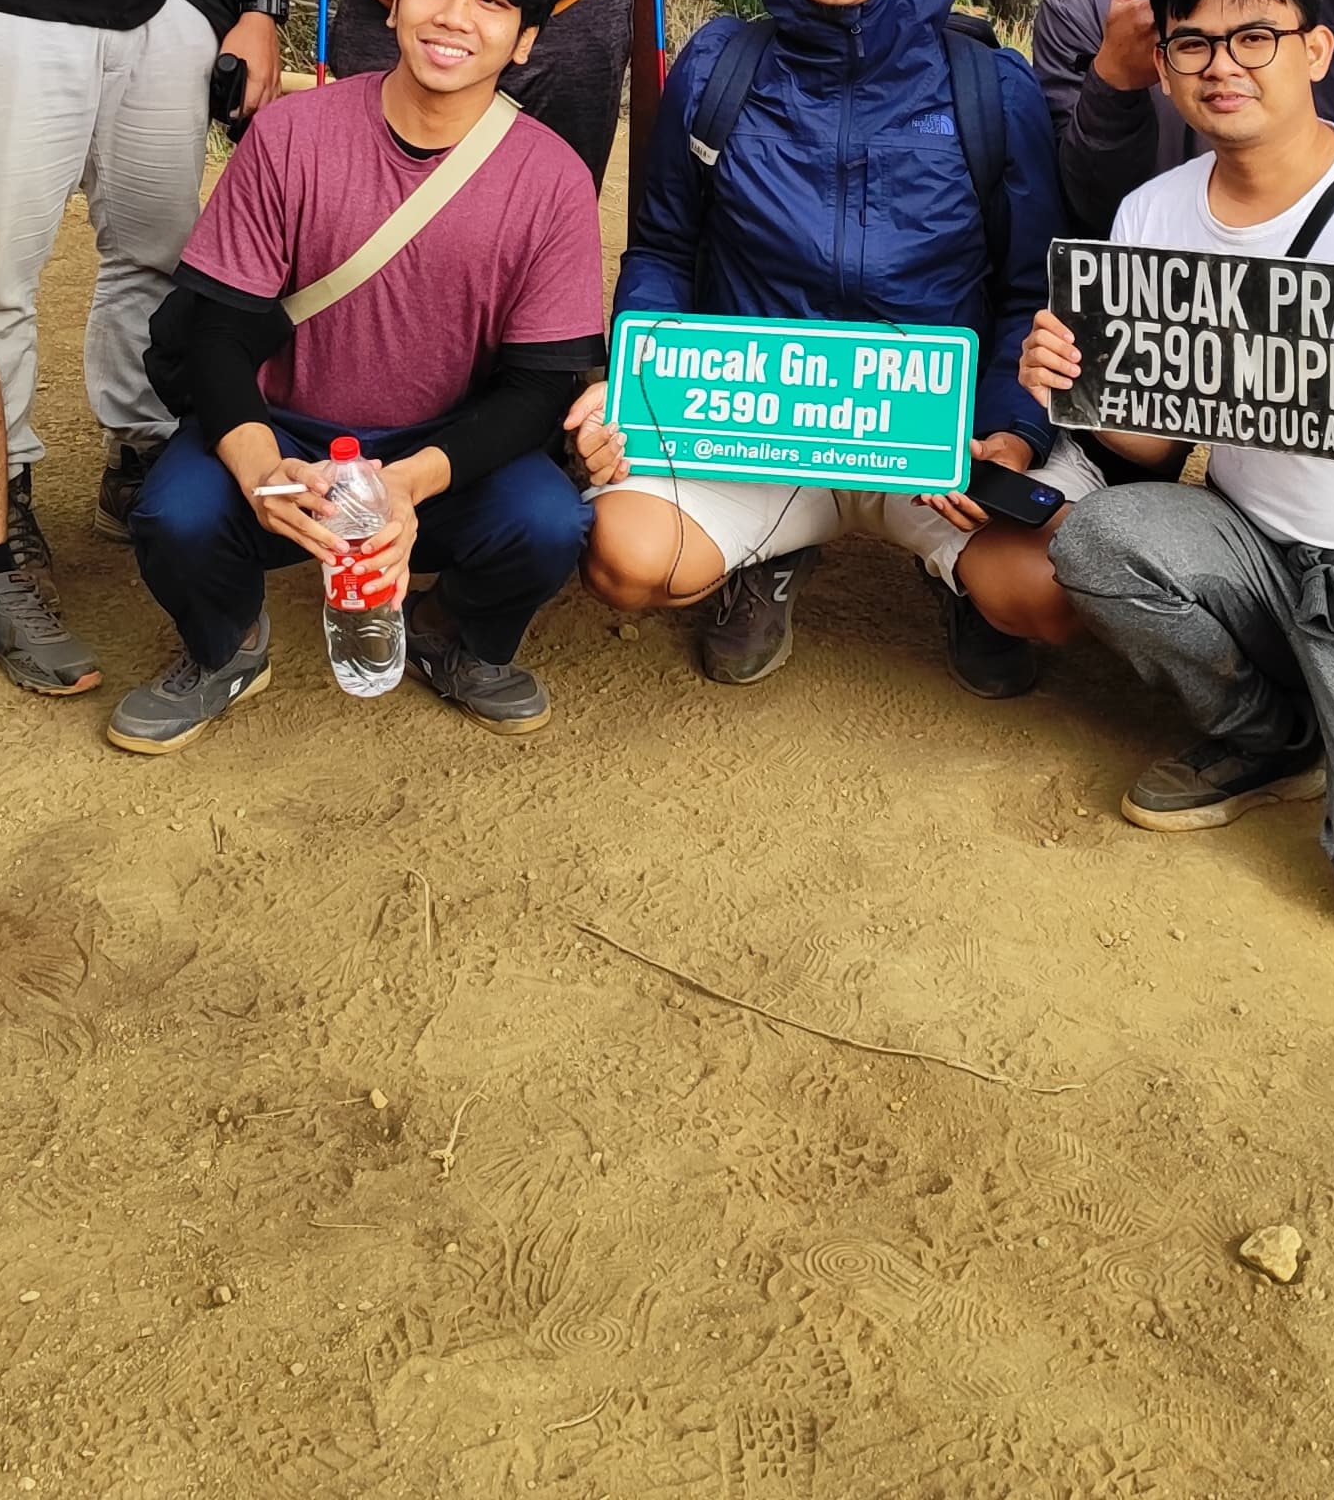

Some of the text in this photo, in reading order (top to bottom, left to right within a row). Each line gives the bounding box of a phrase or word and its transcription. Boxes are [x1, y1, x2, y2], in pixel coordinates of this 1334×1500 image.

[1070, 250, 1250, 331] PUNCAK
[631, 334, 954, 395] Puncak Gn. PRAU
[1104, 320, 1222, 395] 2590
[682, 388, 892, 438] 2590 mdpl
